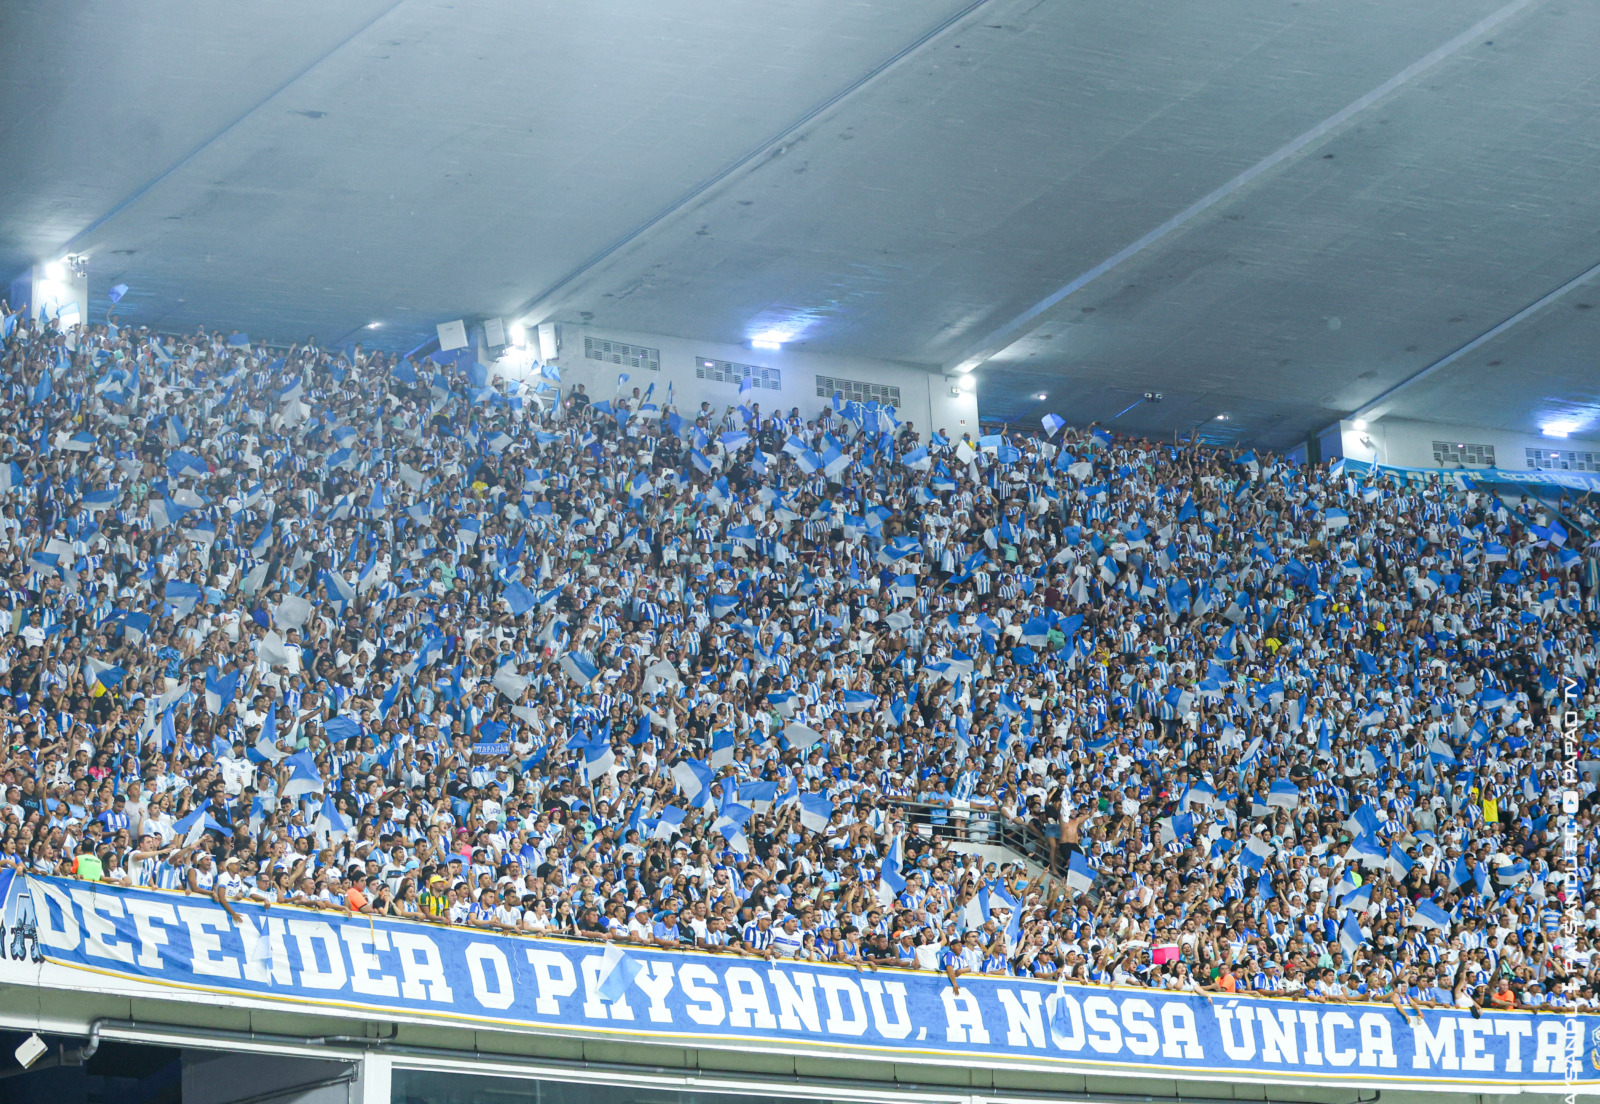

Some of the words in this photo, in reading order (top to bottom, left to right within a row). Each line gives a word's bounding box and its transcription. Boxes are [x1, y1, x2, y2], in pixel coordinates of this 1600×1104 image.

[30, 876, 454, 1004] DEFENDER
[464, 942, 516, 1010] O
[526, 948, 927, 1041] PAYSANDU,
[939, 986, 990, 1044] A
[996, 988, 1204, 1060] NOSSA
[1214, 998, 1397, 1069] ÚNICA
